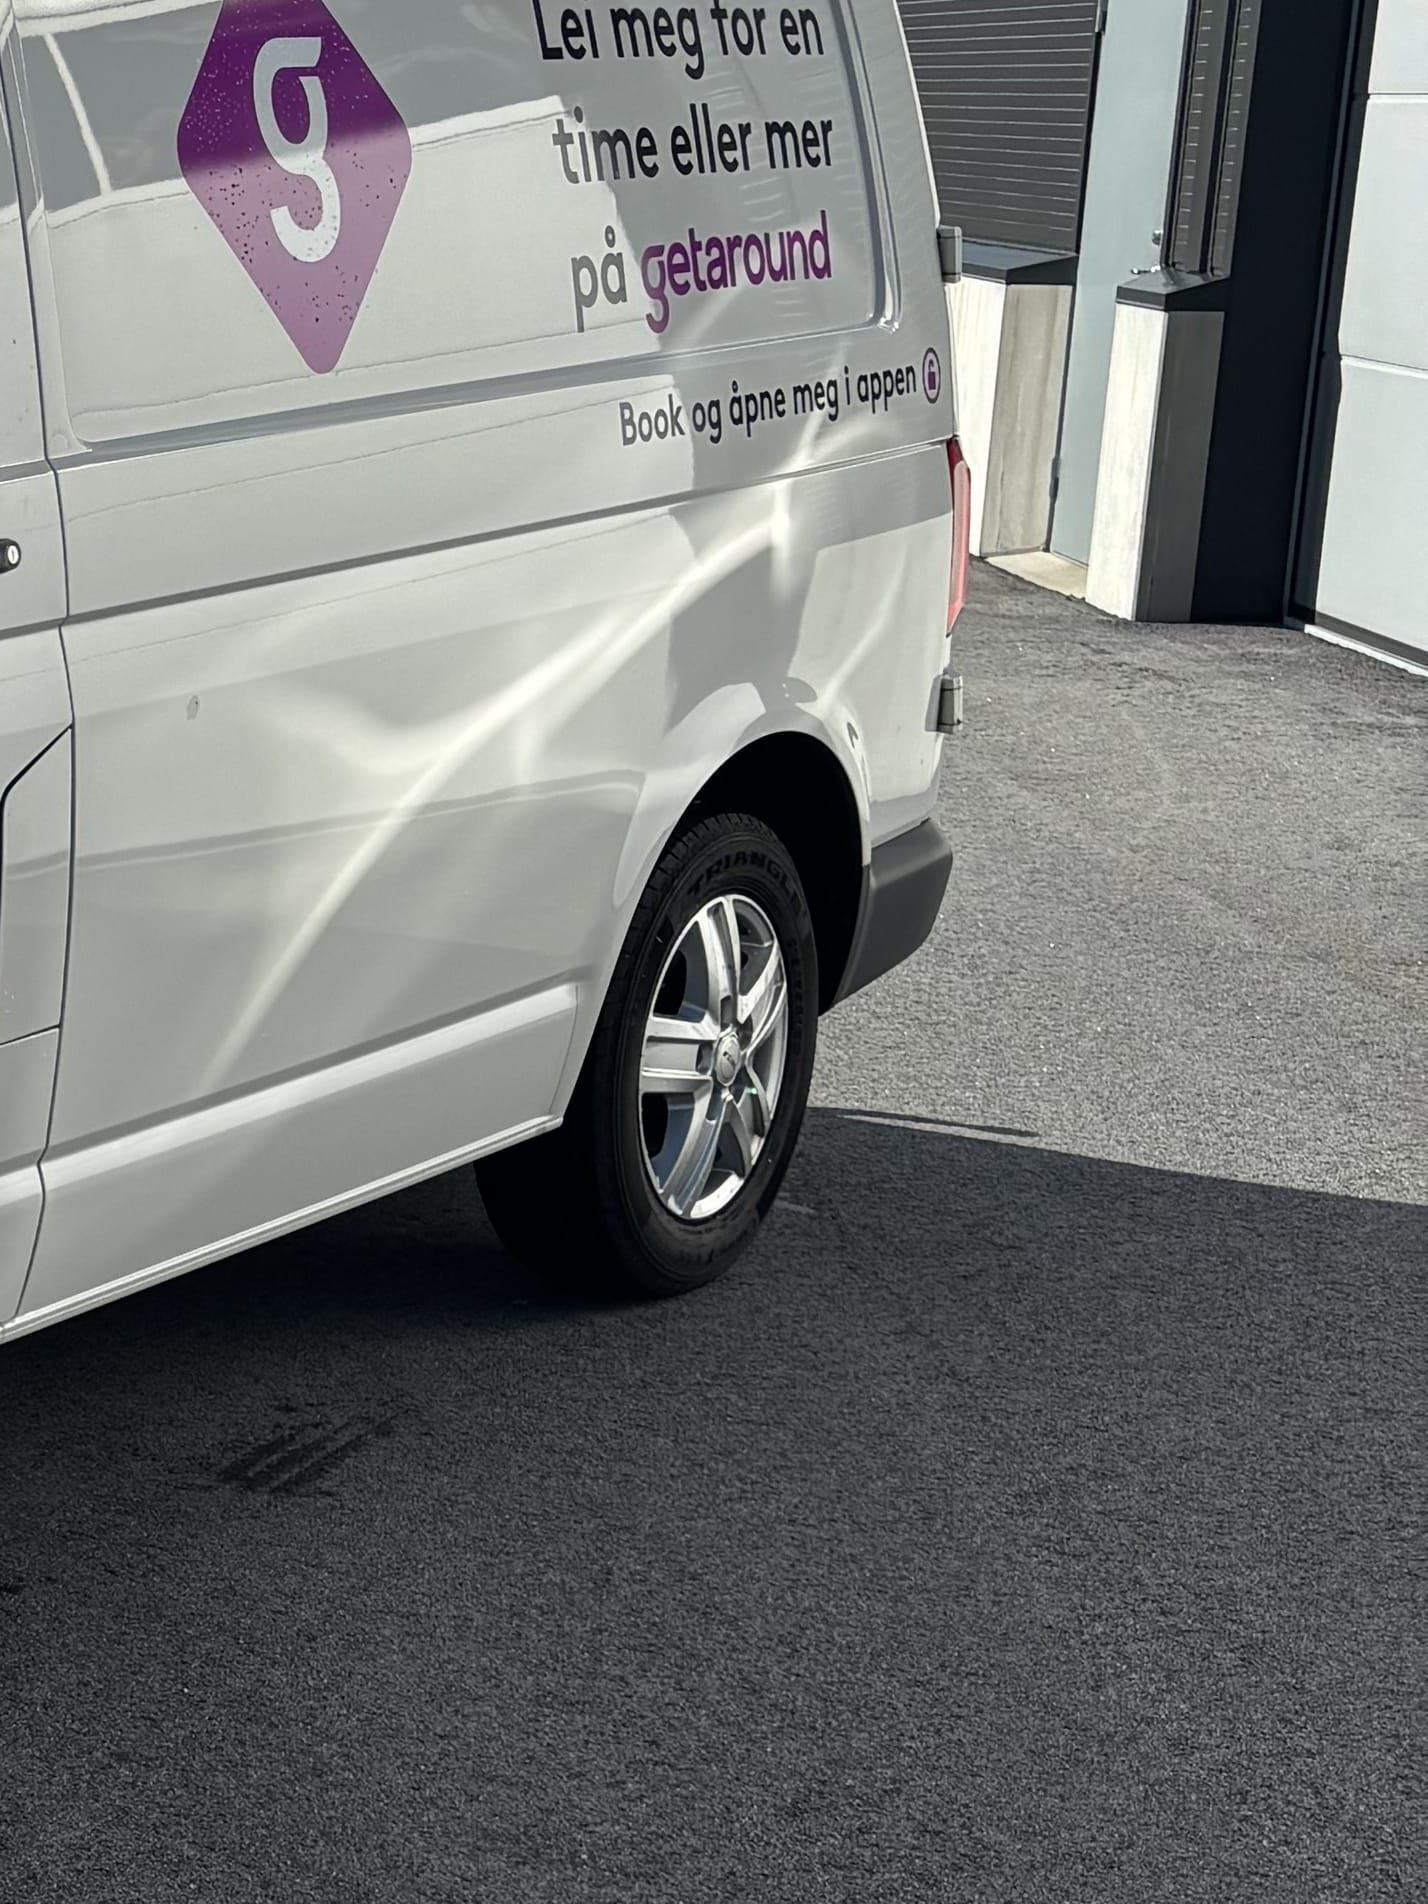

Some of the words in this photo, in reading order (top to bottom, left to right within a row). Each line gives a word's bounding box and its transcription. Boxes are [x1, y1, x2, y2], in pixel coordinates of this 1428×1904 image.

[609, 7, 705, 80] meg
[779, 8, 825, 56] en
[252, 36, 341, 263] g
[551, 105, 660, 184] time
[670, 102, 752, 176] eller
[764, 119, 833, 170] mer
[570, 225, 628, 333] på
[641, 209, 833, 334] getaround
[618, 393, 686, 446] Book
[692, 396, 722, 444] og
[729, 380, 786, 438] åpne
[793, 374, 839, 422] meg
[844, 365, 851, 406] i
[856, 364, 917, 414] appen
